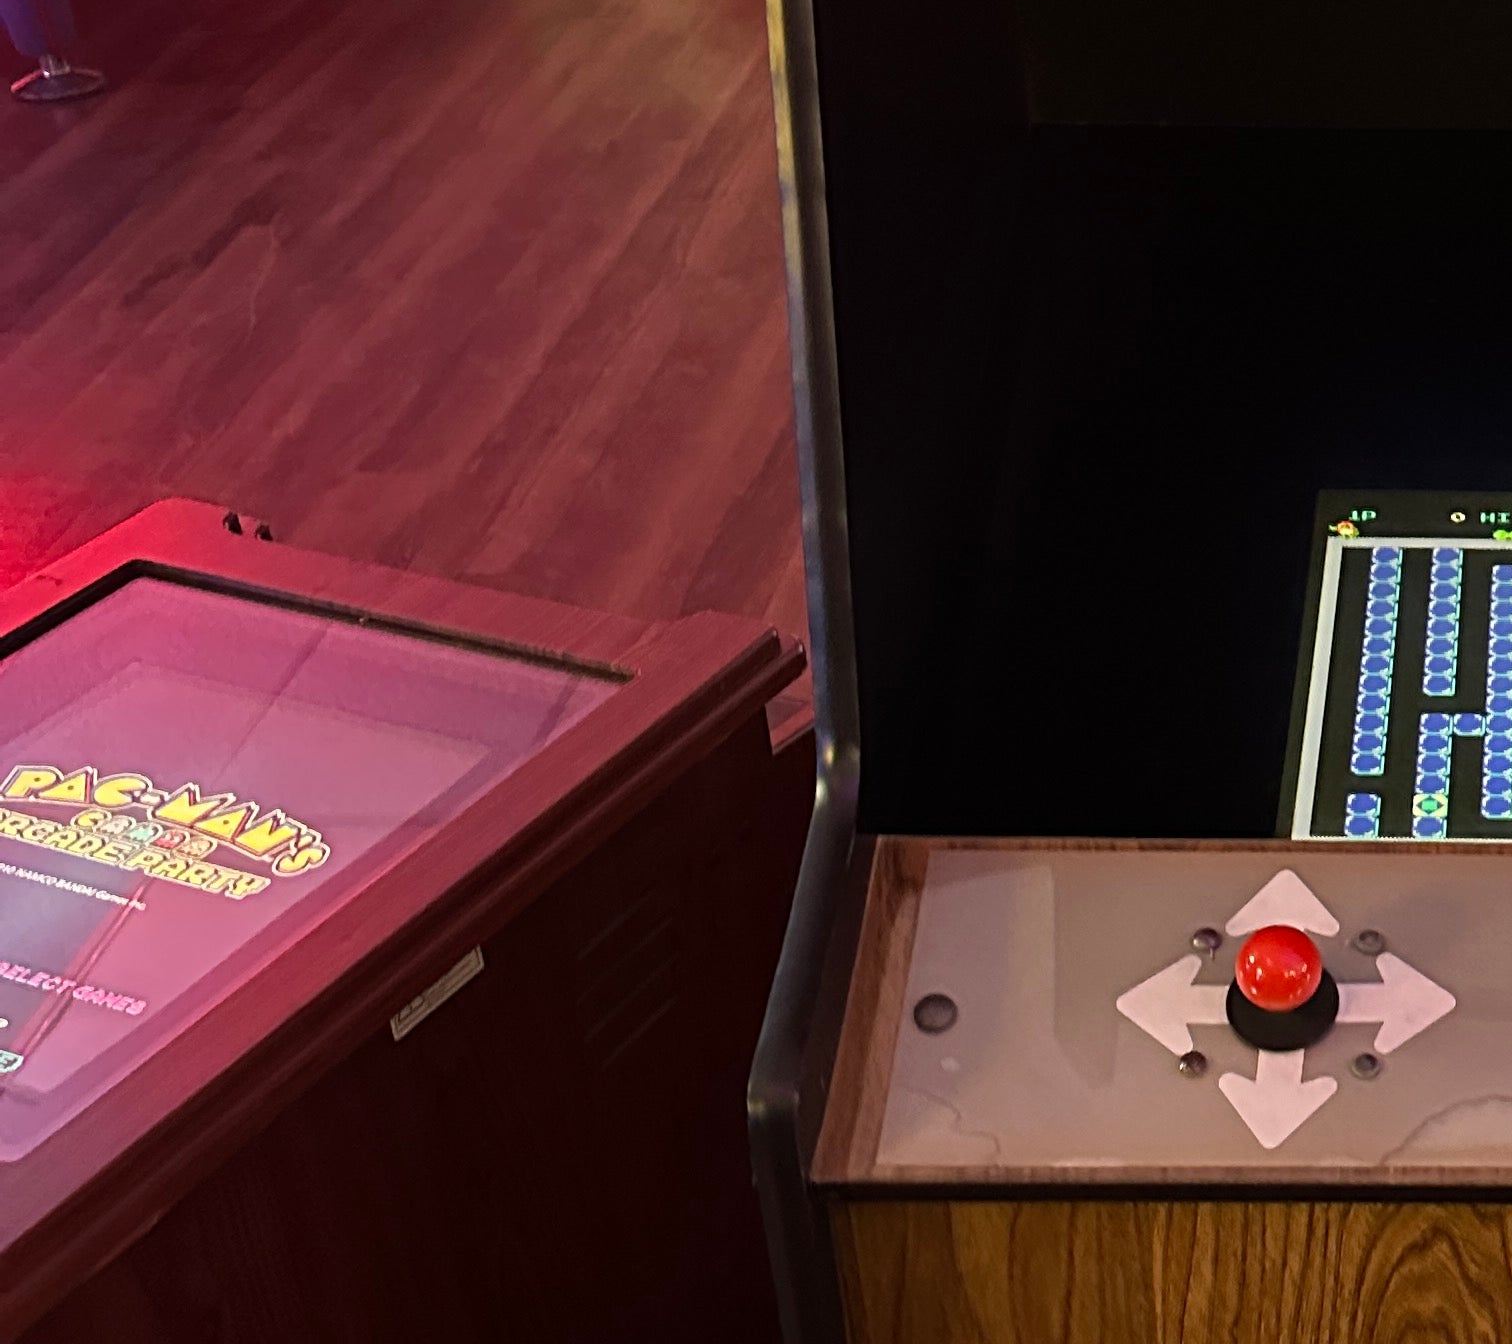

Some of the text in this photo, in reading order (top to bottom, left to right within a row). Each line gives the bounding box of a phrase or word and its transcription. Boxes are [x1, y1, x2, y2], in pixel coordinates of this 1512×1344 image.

[1480, 511, 1511, 524] HI
[0, 810, 271, 900] RCADE PARTY
